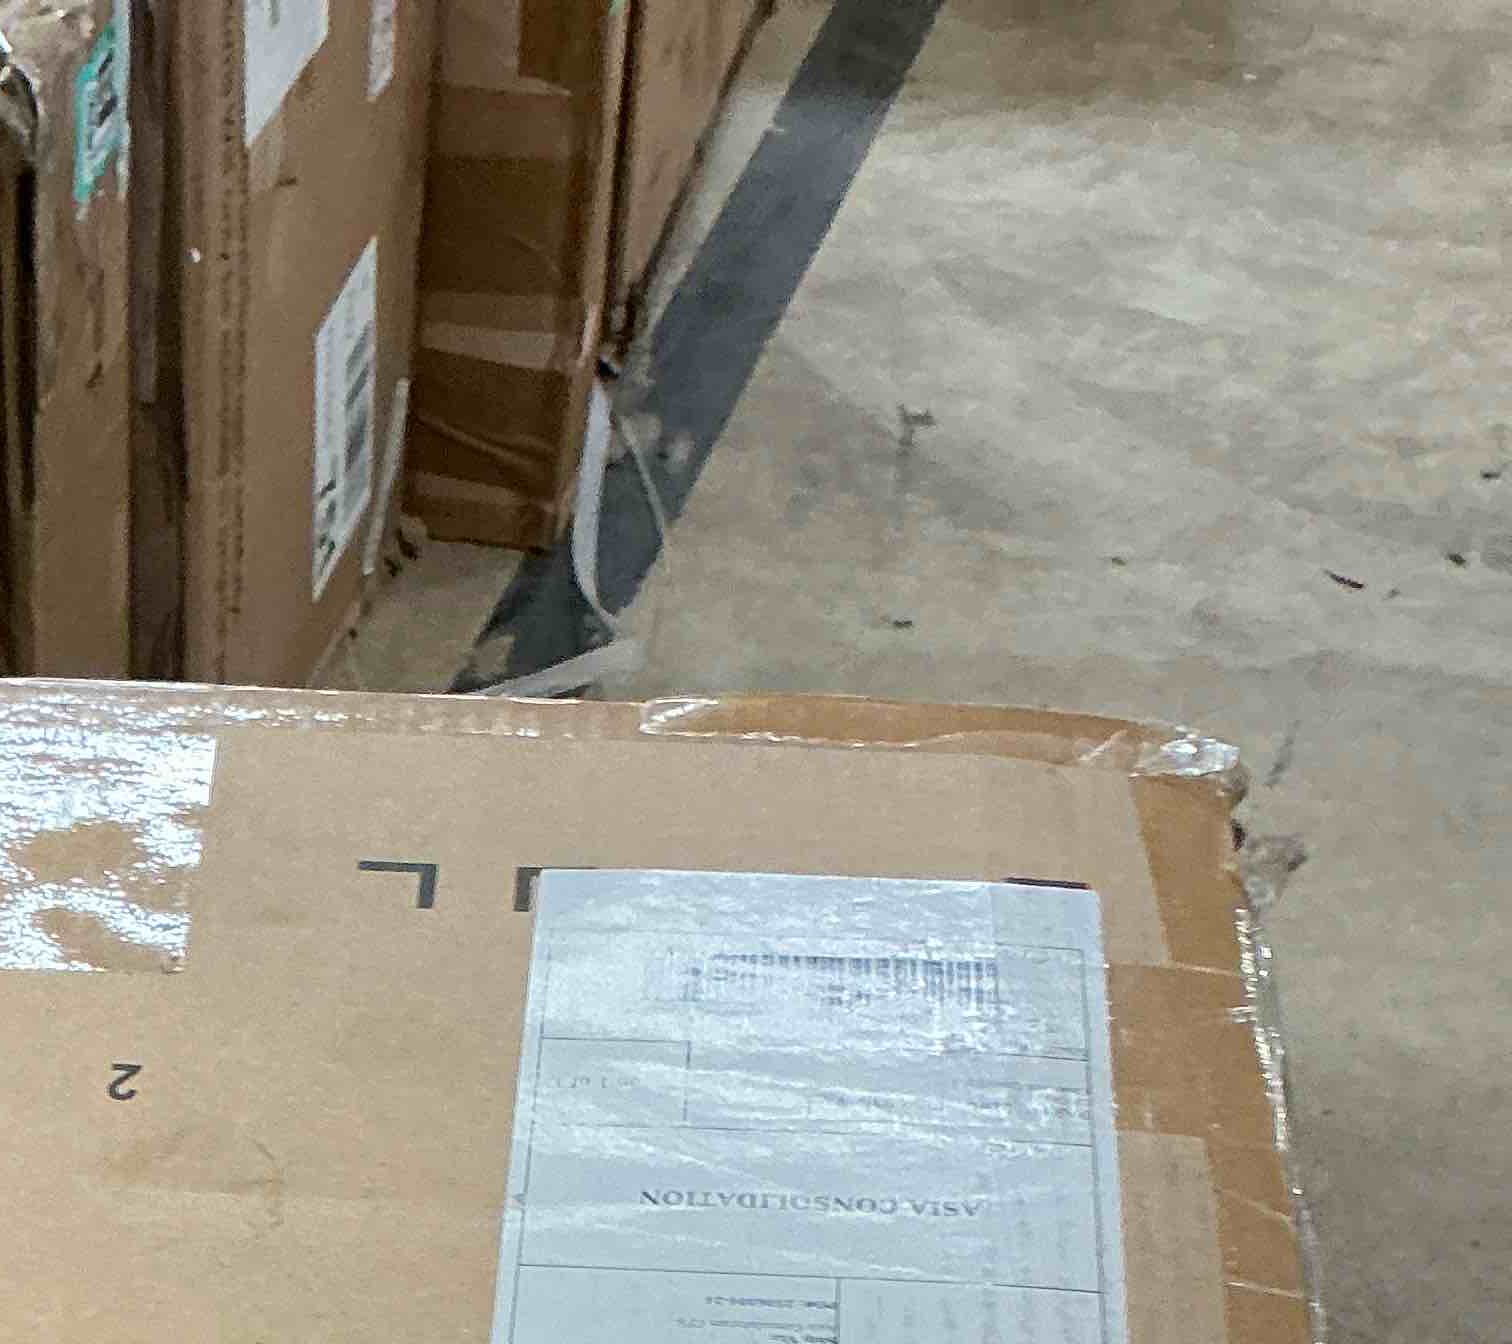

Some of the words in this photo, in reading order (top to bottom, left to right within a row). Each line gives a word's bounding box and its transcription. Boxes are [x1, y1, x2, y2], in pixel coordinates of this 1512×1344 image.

[107, 1063, 143, 1101] 2
[638, 1188, 899, 1216] CONSOLIDATION
[907, 1198, 984, 1218] ASIA
